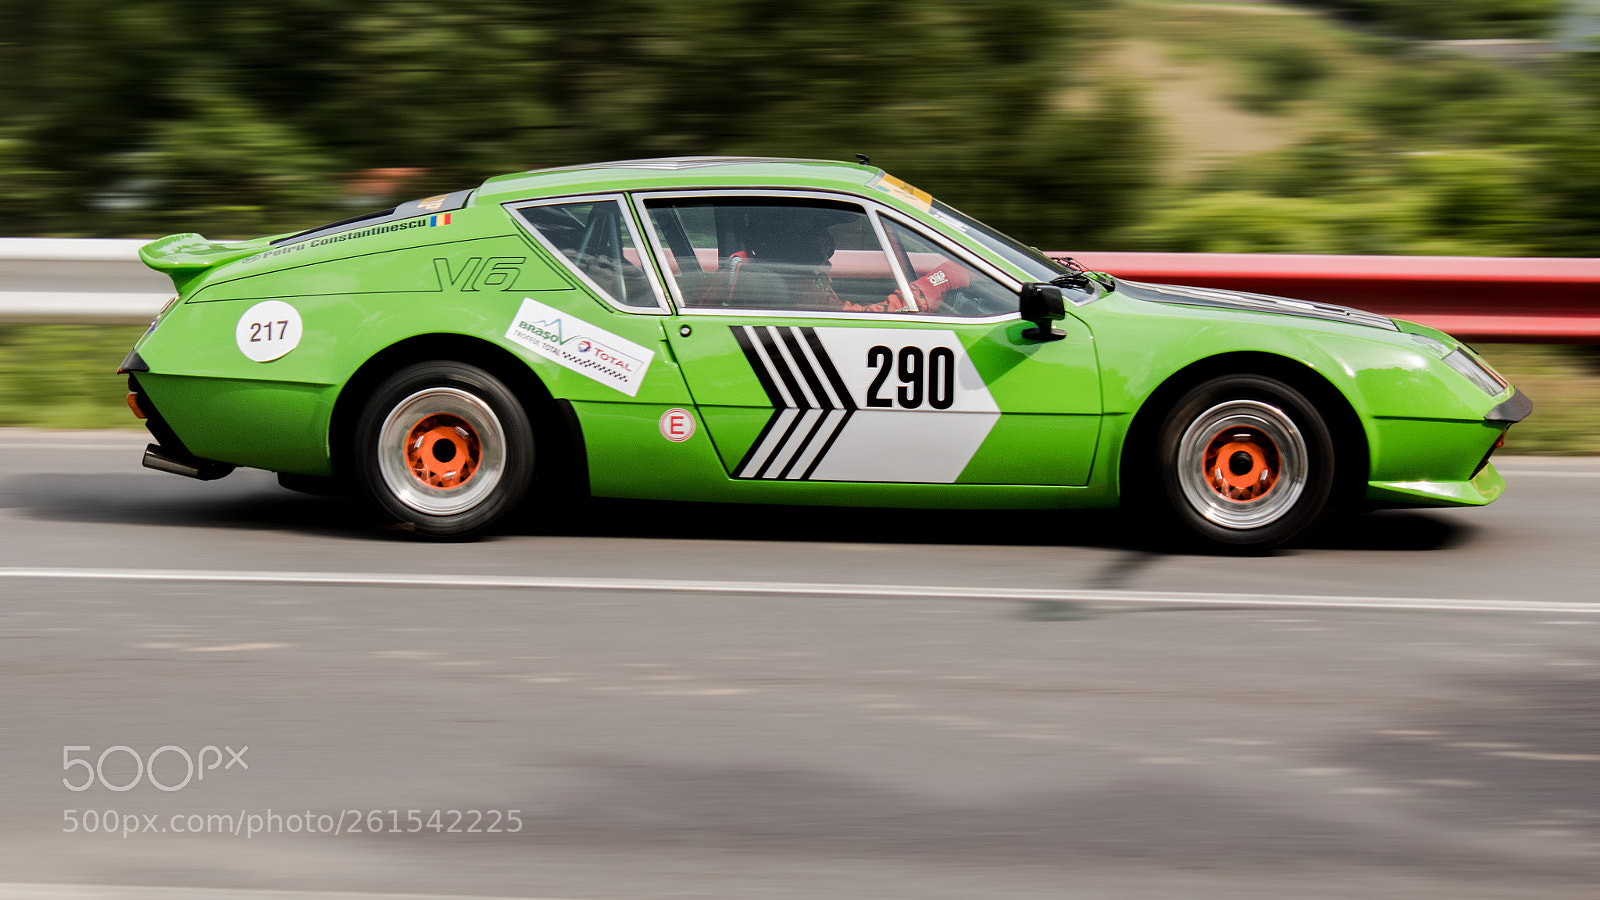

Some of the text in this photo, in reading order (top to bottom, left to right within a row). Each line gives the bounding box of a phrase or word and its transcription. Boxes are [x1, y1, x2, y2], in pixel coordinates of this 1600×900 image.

[263, 218, 426, 259] Petru Constantinescu
[433, 256, 527, 292] V6
[249, 320, 289, 343] 217
[594, 347, 633, 372] TOTAL
[866, 345, 955, 410] 290
[670, 415, 684, 435] E
